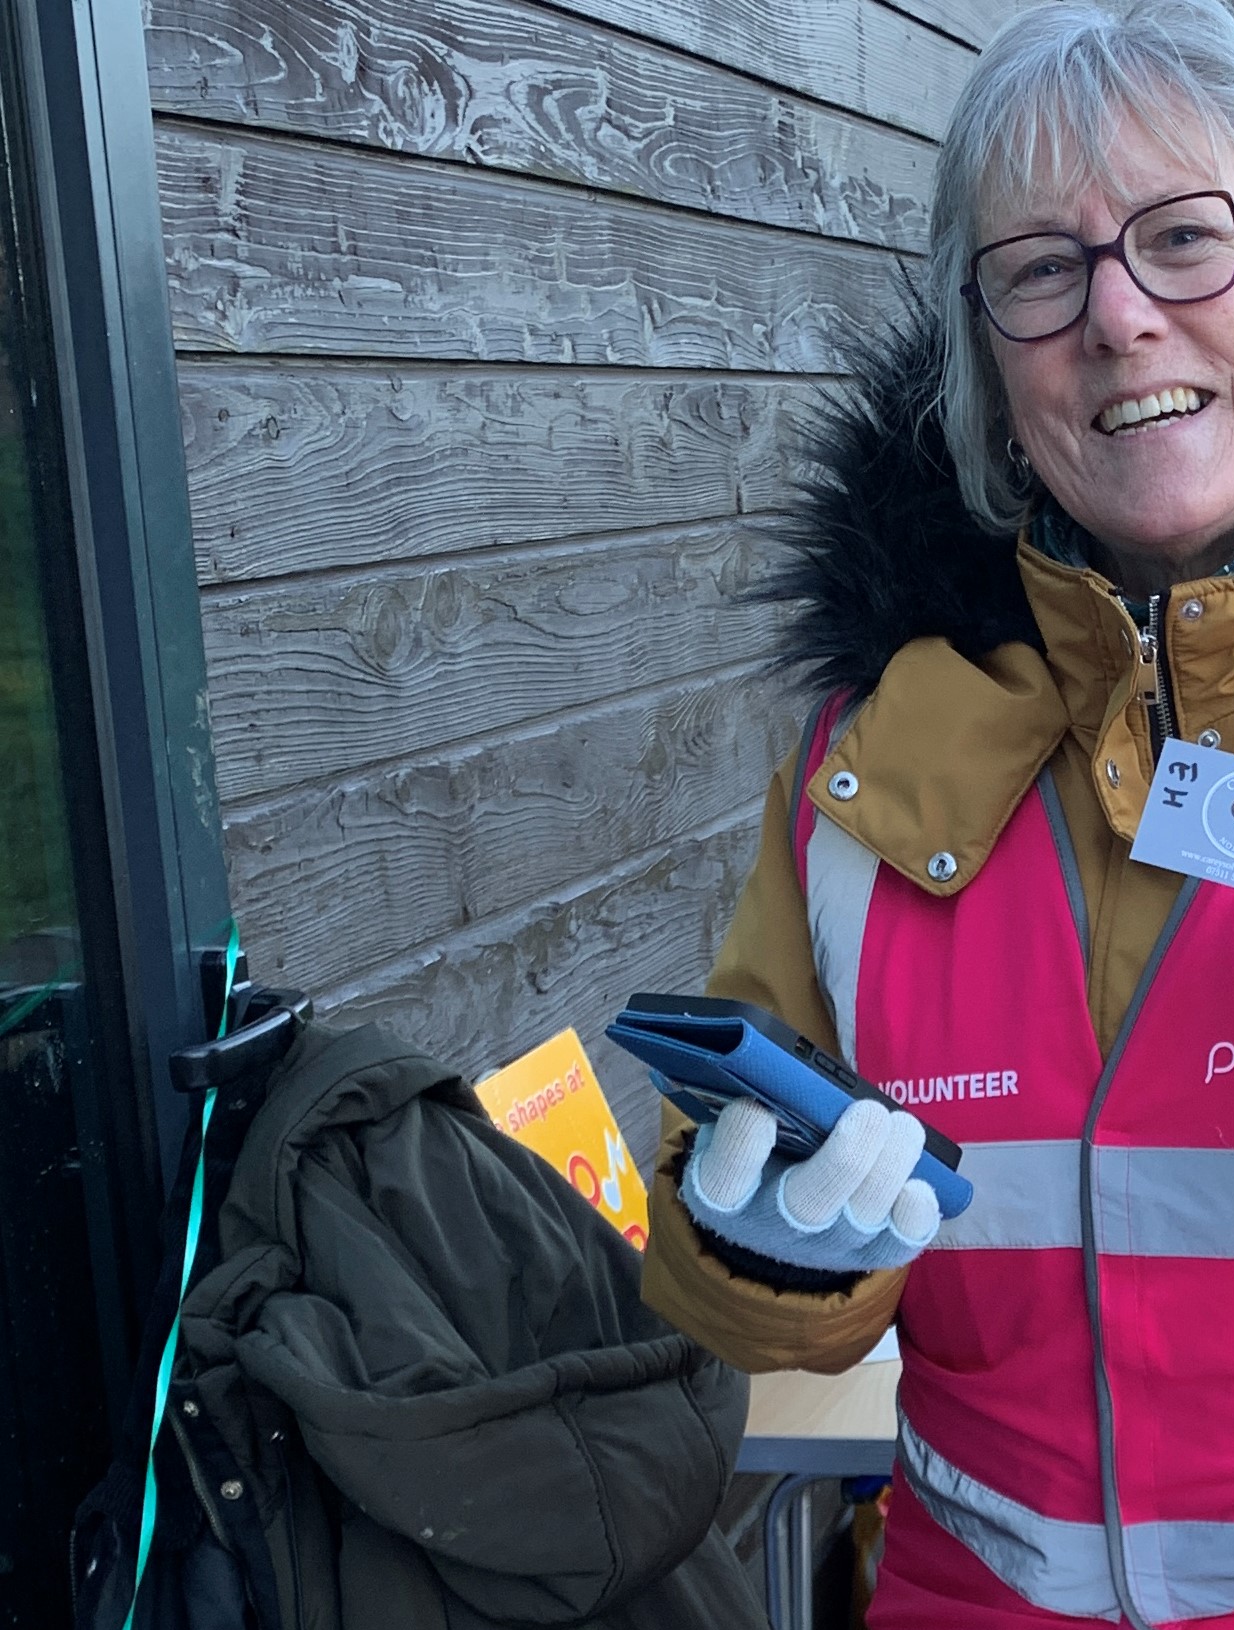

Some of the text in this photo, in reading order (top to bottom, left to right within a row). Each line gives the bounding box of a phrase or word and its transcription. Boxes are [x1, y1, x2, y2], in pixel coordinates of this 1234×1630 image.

[508, 1062, 586, 1133] shapes at
[878, 1069, 1019, 1105] VOLUNTEER
